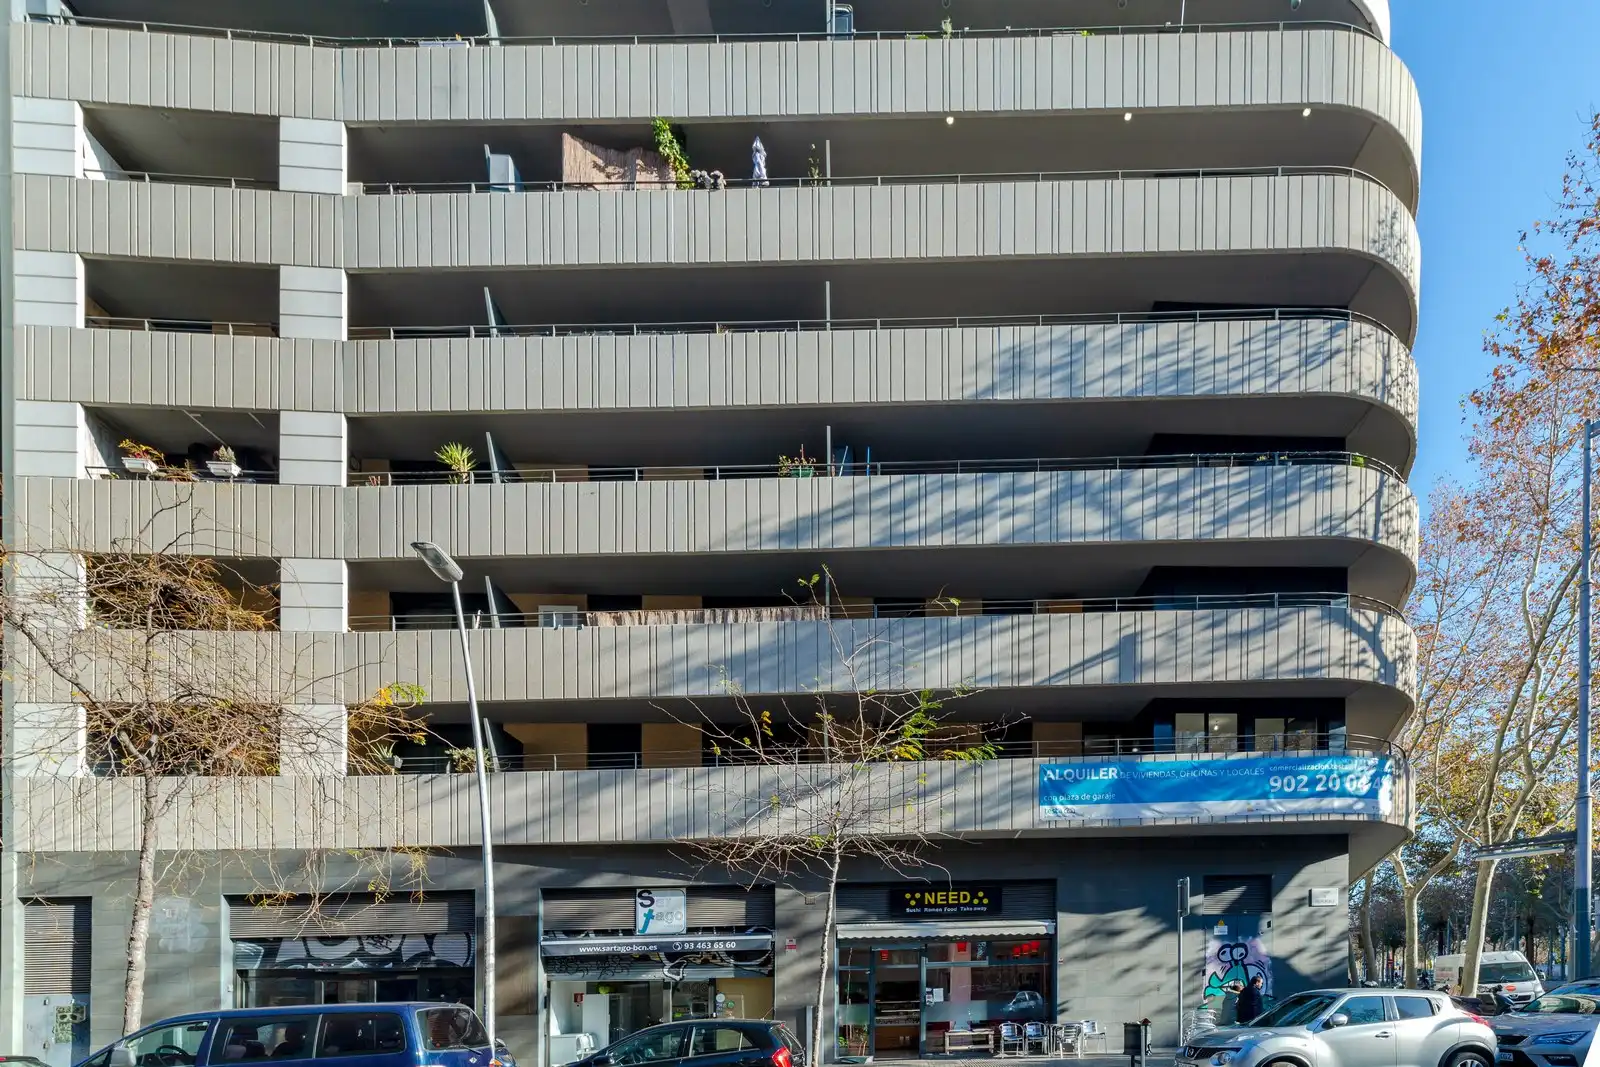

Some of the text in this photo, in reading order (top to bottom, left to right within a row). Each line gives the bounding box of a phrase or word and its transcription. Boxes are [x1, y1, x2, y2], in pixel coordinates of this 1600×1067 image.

[1043, 767, 1118, 783] ALQUILER
[1119, 771, 1132, 779] DE
[1179, 769, 1218, 778] OFICINAS
[1226, 768, 1265, 776] LOCALES
[1269, 774, 1309, 793] 902
[1315, 773, 1341, 792] 20
[1080, 792, 1091, 801] de
[1092, 792, 1116, 802] garaje
[924, 891, 971, 905] NEED
[579, 941, 737, 953] www.sartago-bcn.es 93 463 65 60
